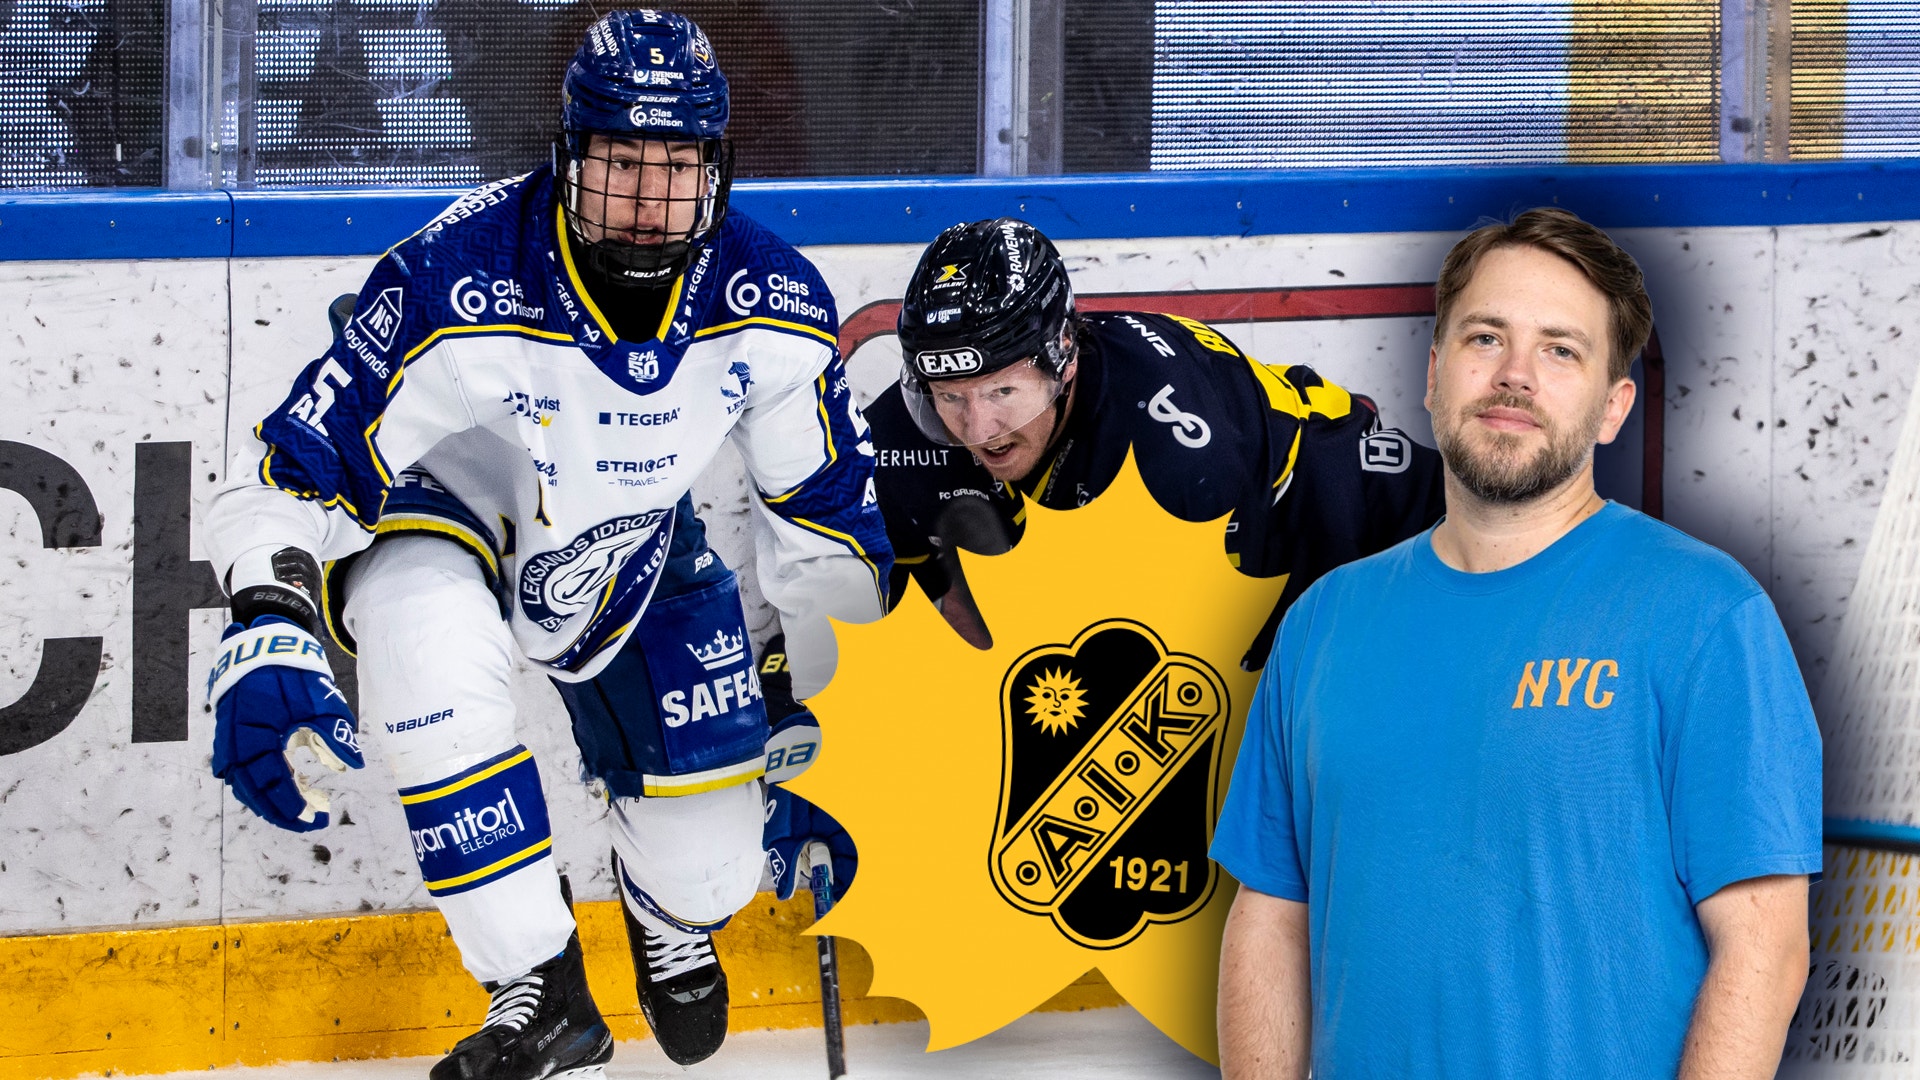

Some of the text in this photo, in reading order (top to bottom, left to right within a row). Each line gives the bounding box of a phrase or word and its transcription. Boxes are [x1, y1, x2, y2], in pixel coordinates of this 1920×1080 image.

[650, 48, 664, 64] 5
[651, 71, 684, 79] SVENSKA
[650, 109, 672, 118] Clas
[650, 118, 683, 128] Ohlson
[686, 248, 714, 302] TEGERA
[767, 273, 810, 297] Clas
[768, 292, 829, 324] Ohlson
[368, 303, 393, 338] NS
[628, 350, 657, 361] SHL
[922, 351, 978, 373] EAB
[628, 359, 659, 379] 50
[617, 409, 678, 426] TEGERA
[617, 477, 659, 487] TRAVEL
[939, 491, 951, 500] FC
[524, 537, 590, 605] LEKSANDS
[253, 591, 310, 615] BAUER
[1511, 658, 1620, 709] NYC
[661, 664, 763, 729] SAFE4
[396, 708, 454, 733] BAUER
[460, 823, 517, 855] ELECTRO
[537, 1017, 569, 1052] BAUER
